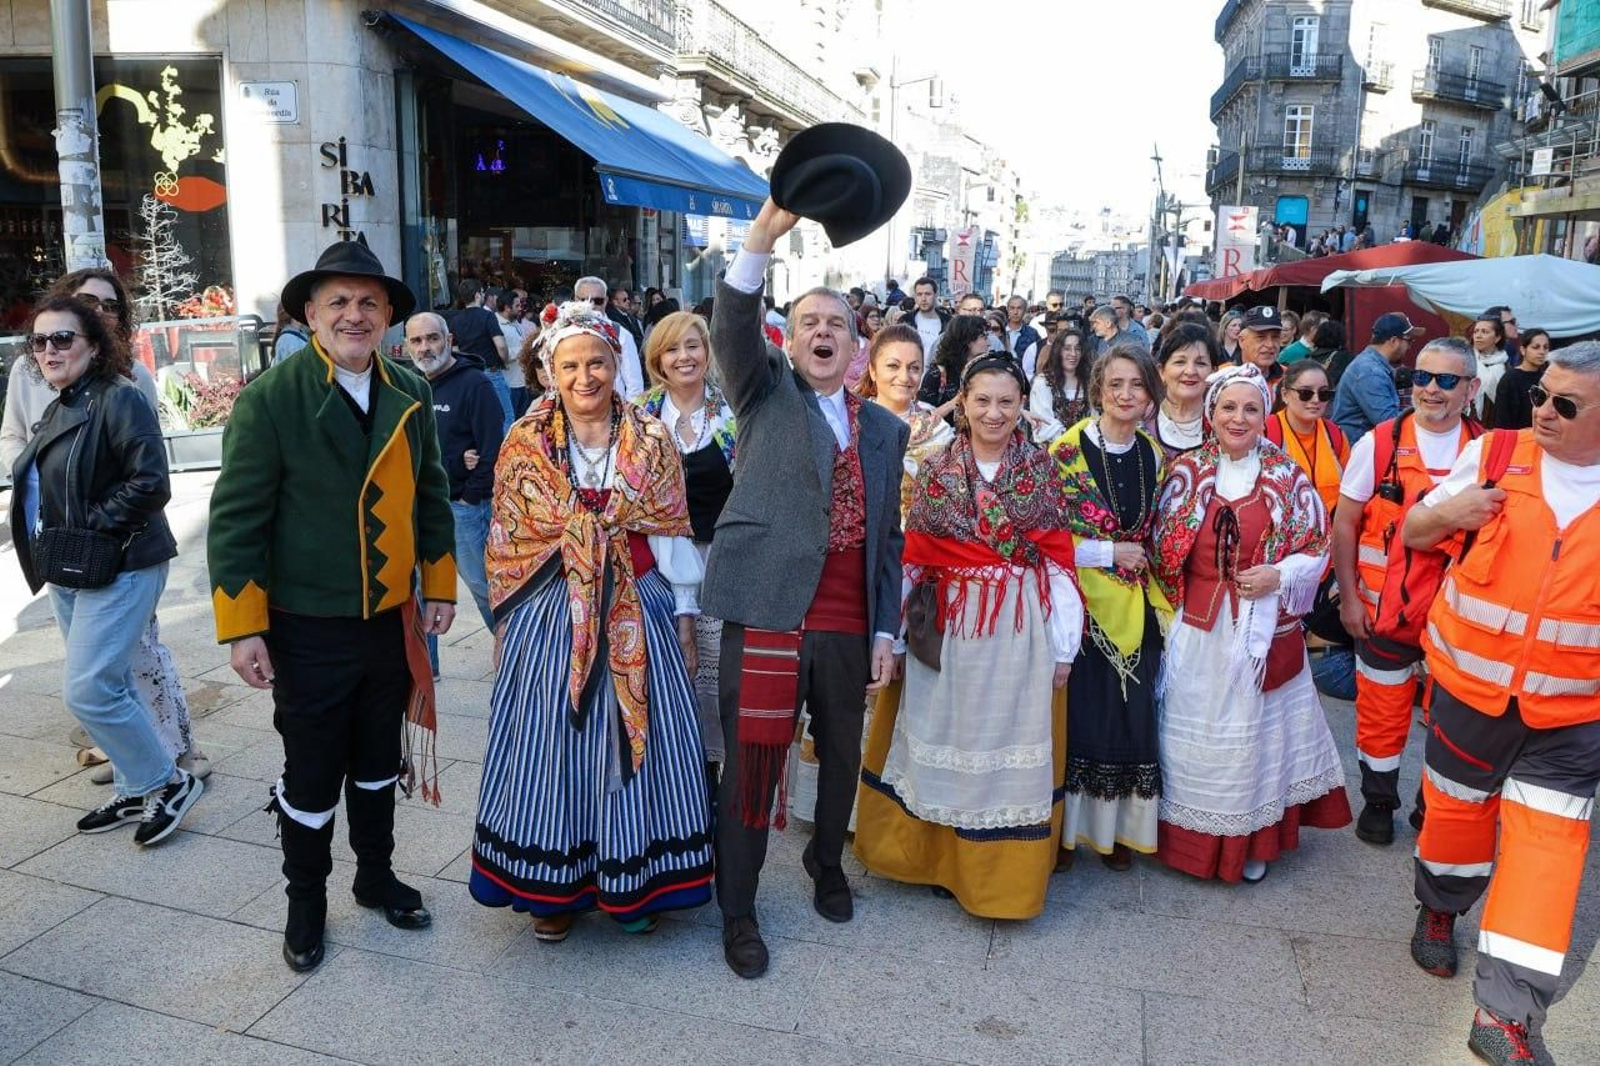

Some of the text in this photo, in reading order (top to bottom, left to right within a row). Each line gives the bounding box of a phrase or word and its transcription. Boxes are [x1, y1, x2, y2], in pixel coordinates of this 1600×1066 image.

[340, 170, 375, 196] BA
[954, 259, 971, 283] R
[1223, 248, 1246, 277] R
